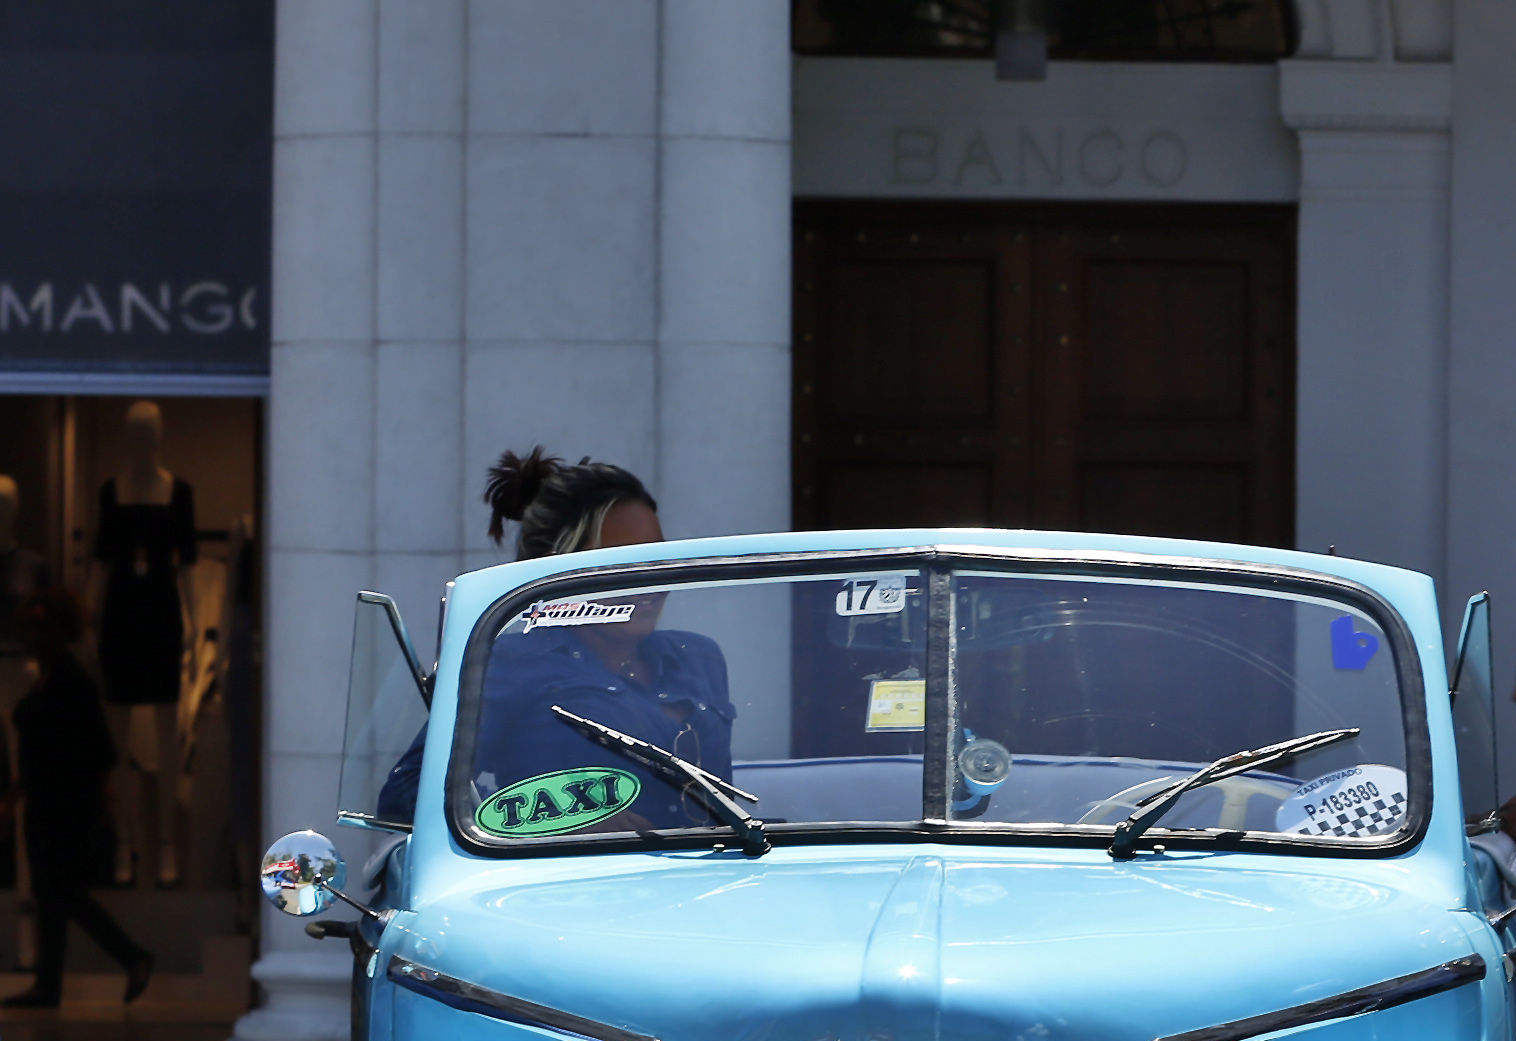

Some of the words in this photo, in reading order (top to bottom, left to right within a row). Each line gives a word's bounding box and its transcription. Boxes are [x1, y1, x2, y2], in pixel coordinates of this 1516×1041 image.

[889, 124, 1190, 189] BANCO
[838, 580, 878, 611] 17
[1318, 768, 1363, 786] PRIVADO
[494, 774, 623, 830] TAXI
[1303, 781, 1380, 821] P-183380
